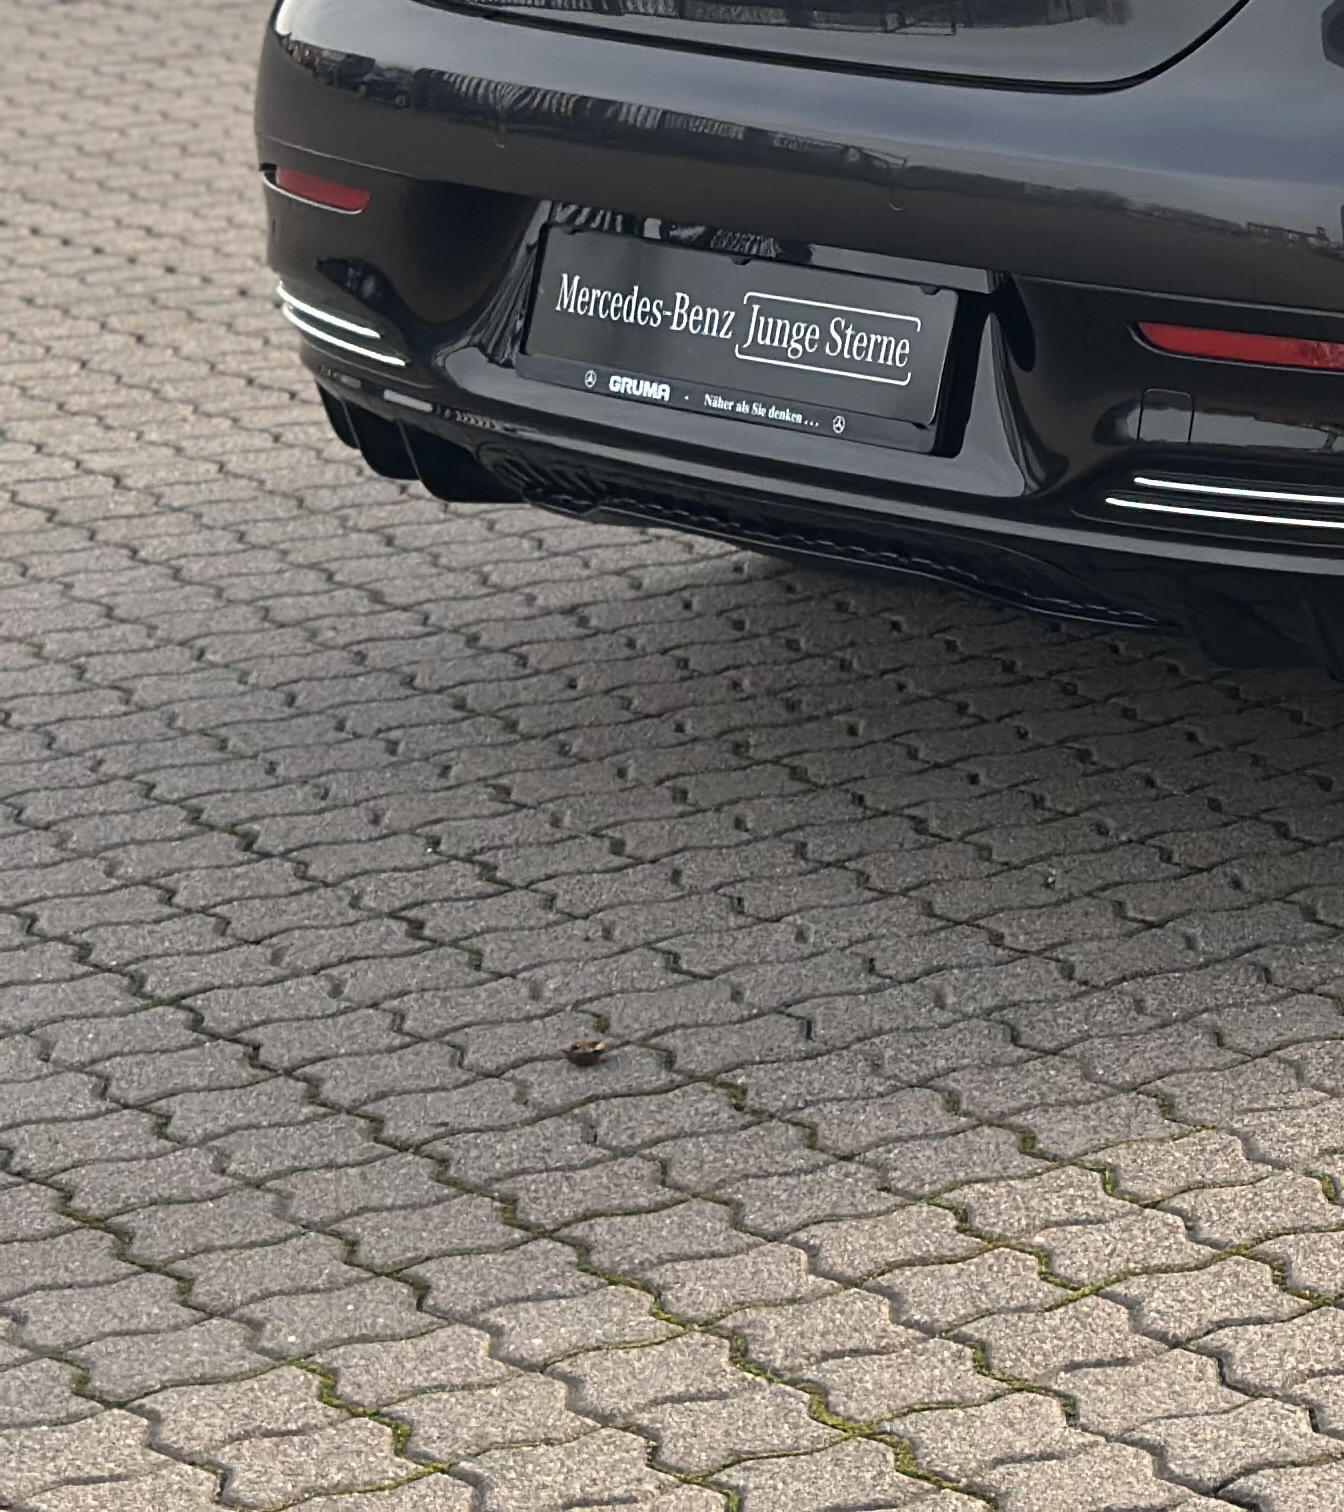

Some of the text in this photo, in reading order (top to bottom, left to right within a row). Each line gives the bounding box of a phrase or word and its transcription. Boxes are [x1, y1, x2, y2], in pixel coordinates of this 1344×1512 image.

[555, 273, 911, 368] Mercedes-Benz Junge Sterne
[608, 375, 671, 402] GRUMA
[704, 392, 735, 412] Näher
[735, 401, 750, 415] als
[751, 402, 767, 418] Sie
